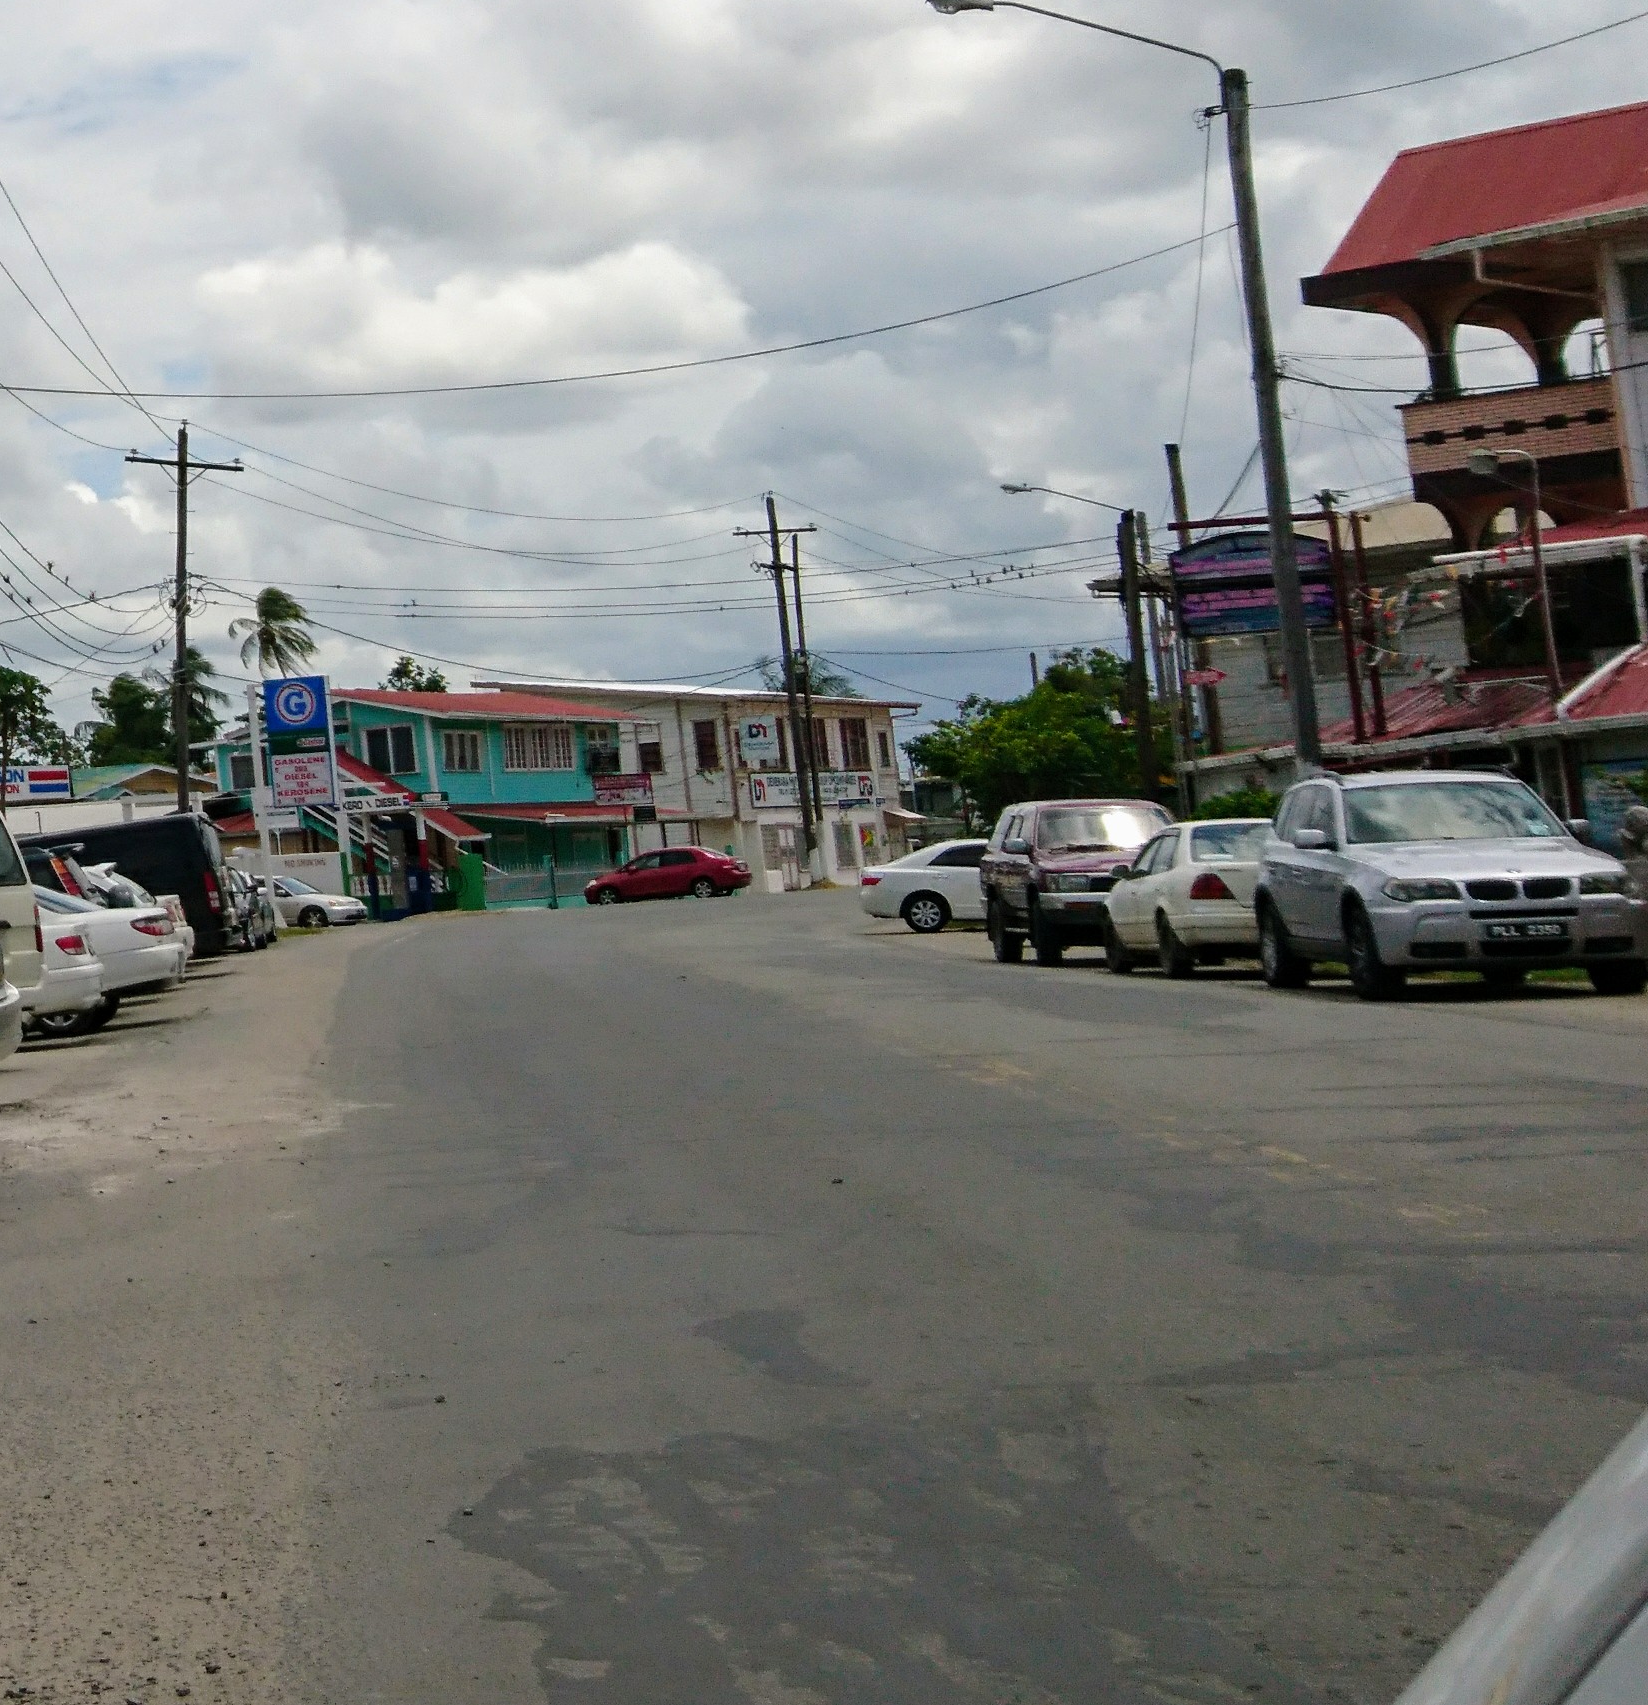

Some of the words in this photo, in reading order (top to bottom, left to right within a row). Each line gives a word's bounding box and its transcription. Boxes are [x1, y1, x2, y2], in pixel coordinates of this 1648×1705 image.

[274, 756, 325, 765] GASOLENE
[277, 787, 328, 796] KEROSENE
[375, 797, 401, 808] DIESEL
